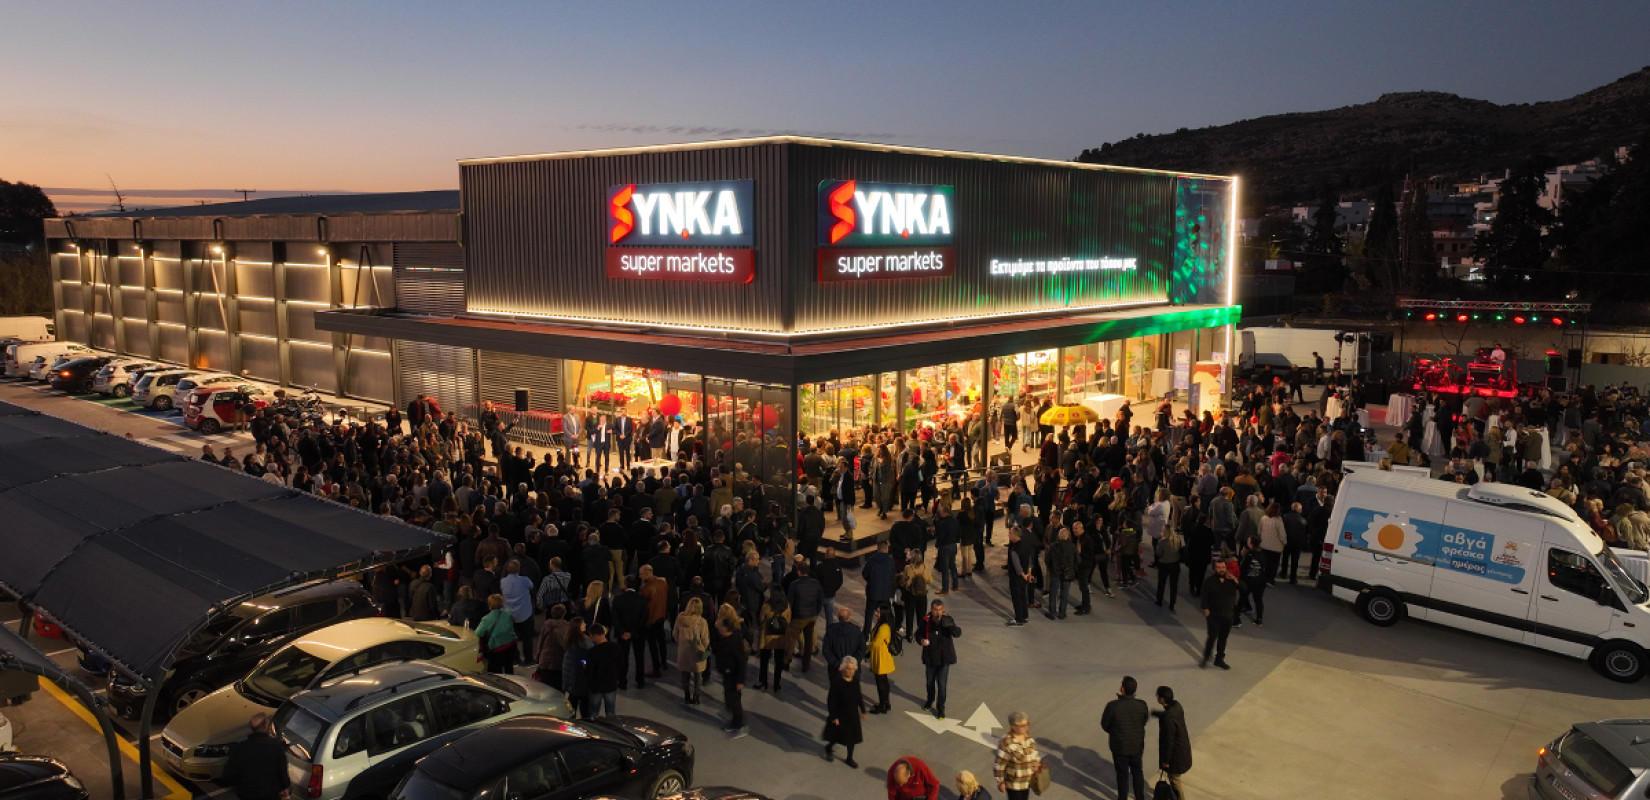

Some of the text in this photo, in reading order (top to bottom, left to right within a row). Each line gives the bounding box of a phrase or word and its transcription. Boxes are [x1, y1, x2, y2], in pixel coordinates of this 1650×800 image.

[621, 253, 735, 274] super markets
[838, 252, 943, 277] super markets
[1441, 546, 1485, 560] φρέσκα
[1451, 559, 1486, 574] ημέρας
